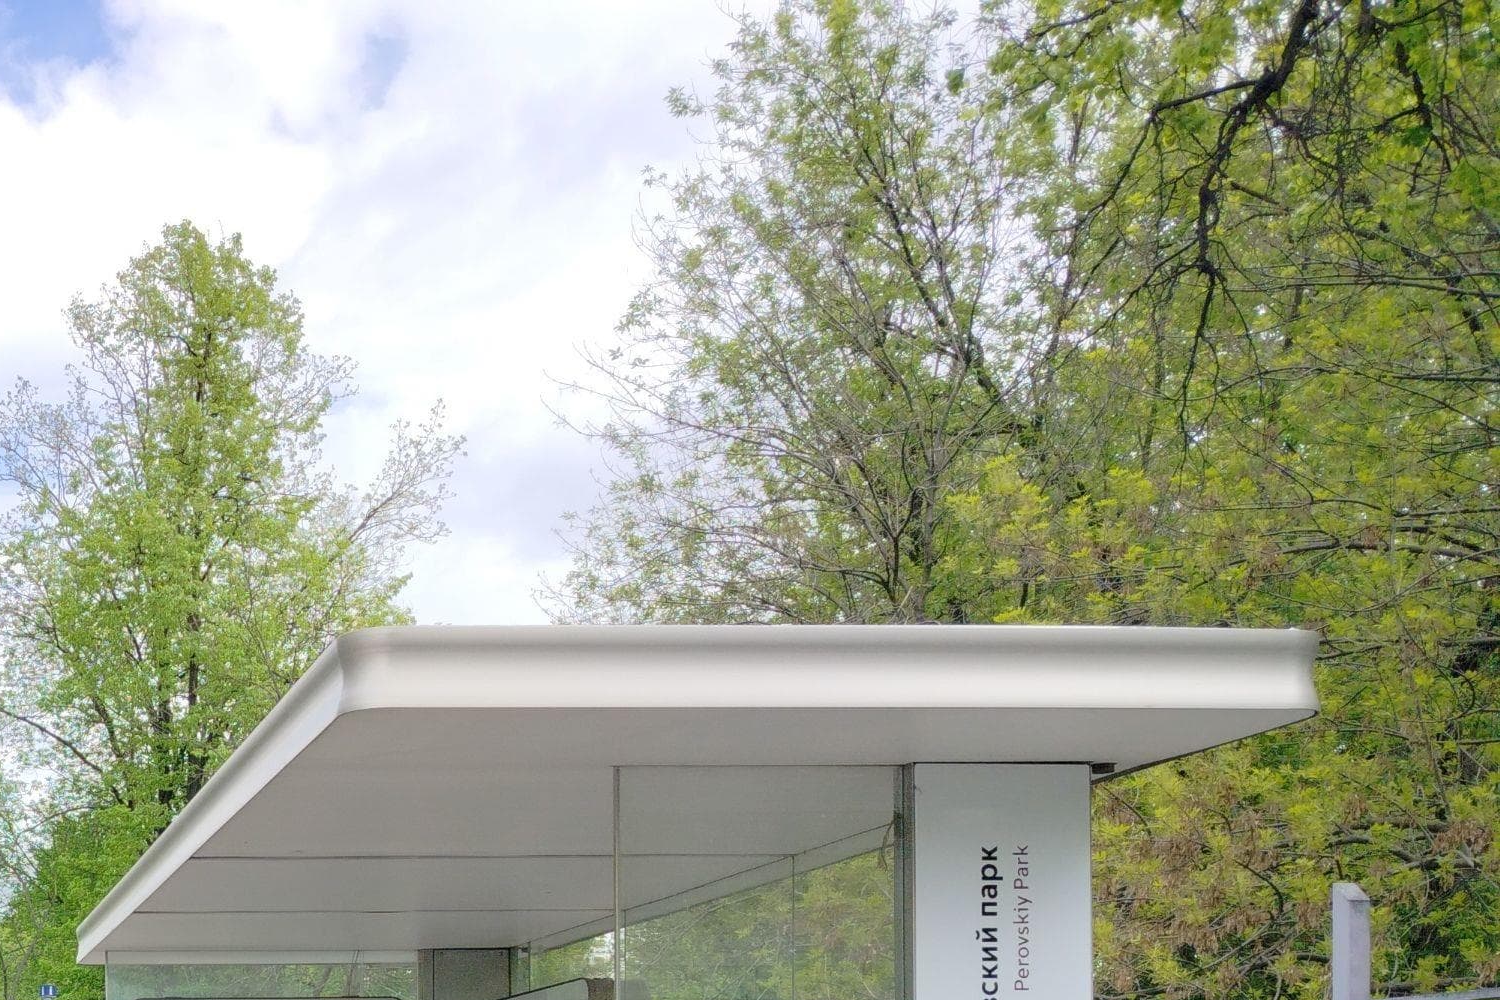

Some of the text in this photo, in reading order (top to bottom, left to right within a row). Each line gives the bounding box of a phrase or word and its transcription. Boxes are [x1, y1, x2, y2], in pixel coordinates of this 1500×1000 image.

[981, 846, 1003, 916] парк
[1012, 845, 1033, 991] Perovskiy Park
